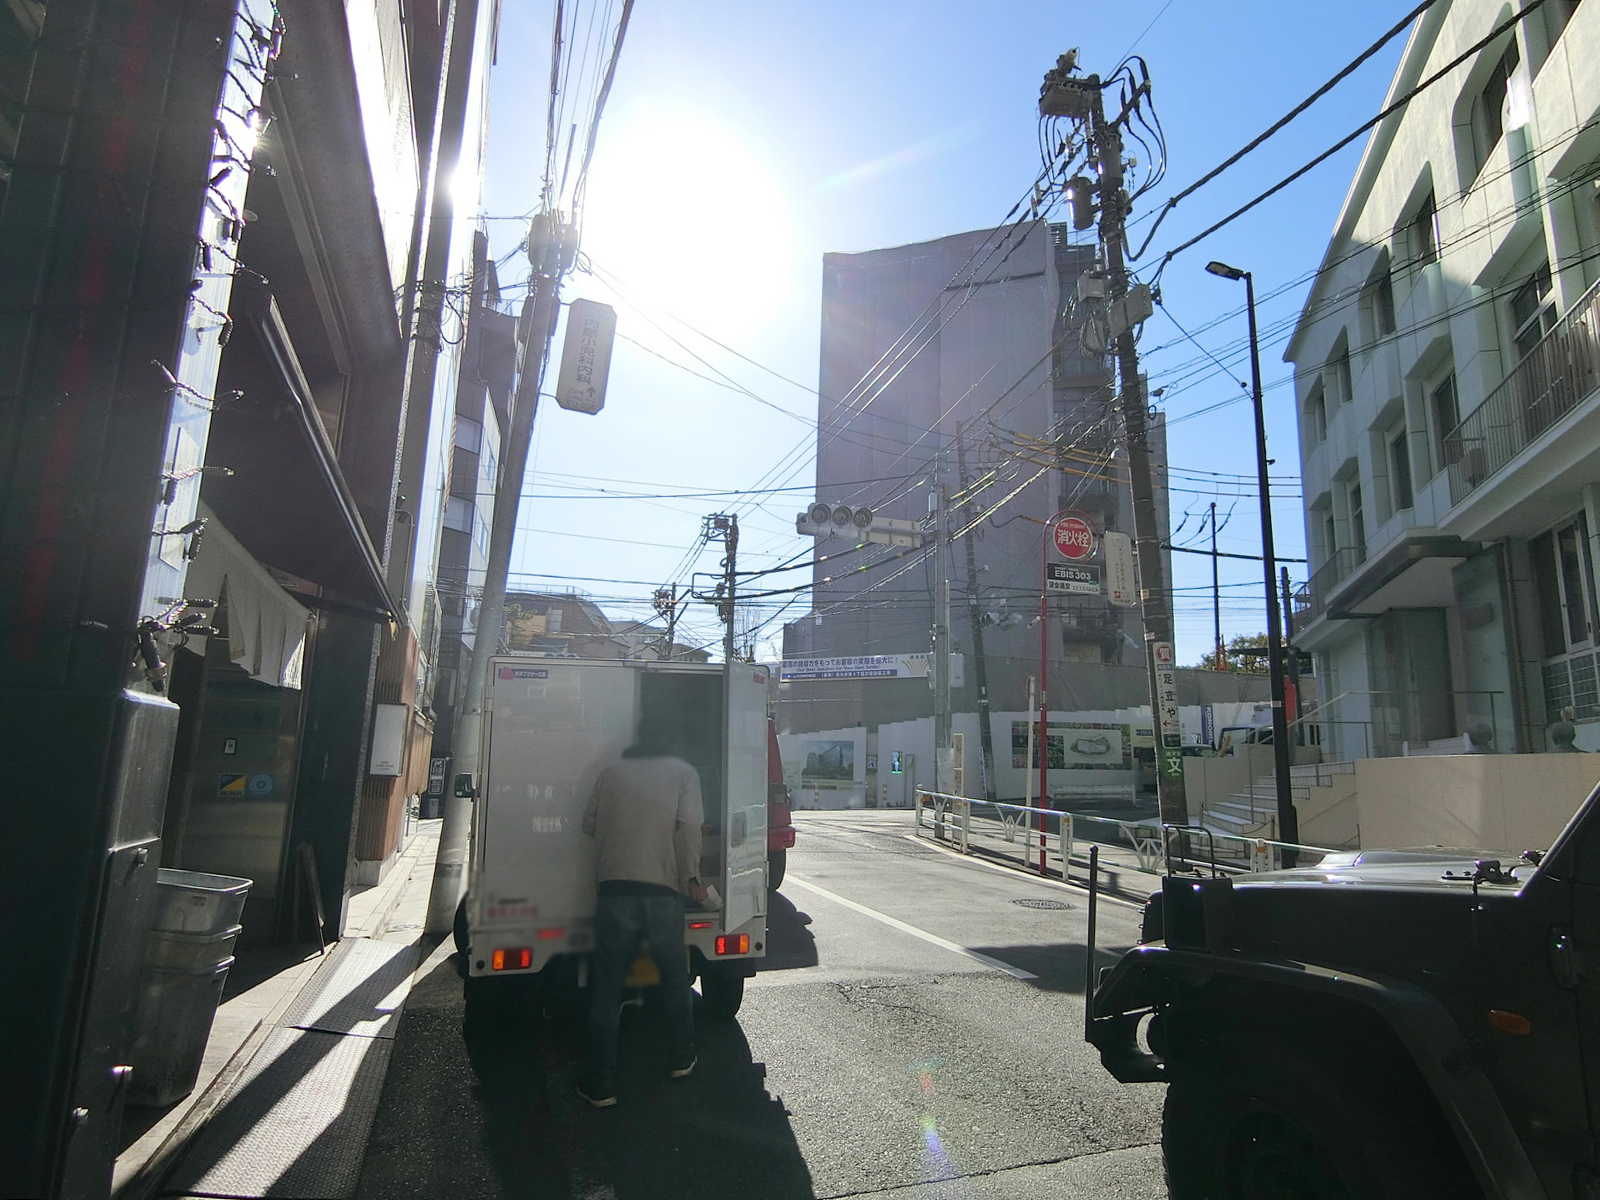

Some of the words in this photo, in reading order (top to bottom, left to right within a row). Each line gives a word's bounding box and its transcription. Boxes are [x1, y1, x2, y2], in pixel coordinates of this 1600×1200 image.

[1057, 529, 1090, 548] 消火栓
[1163, 673, 1176, 719] 足立や
